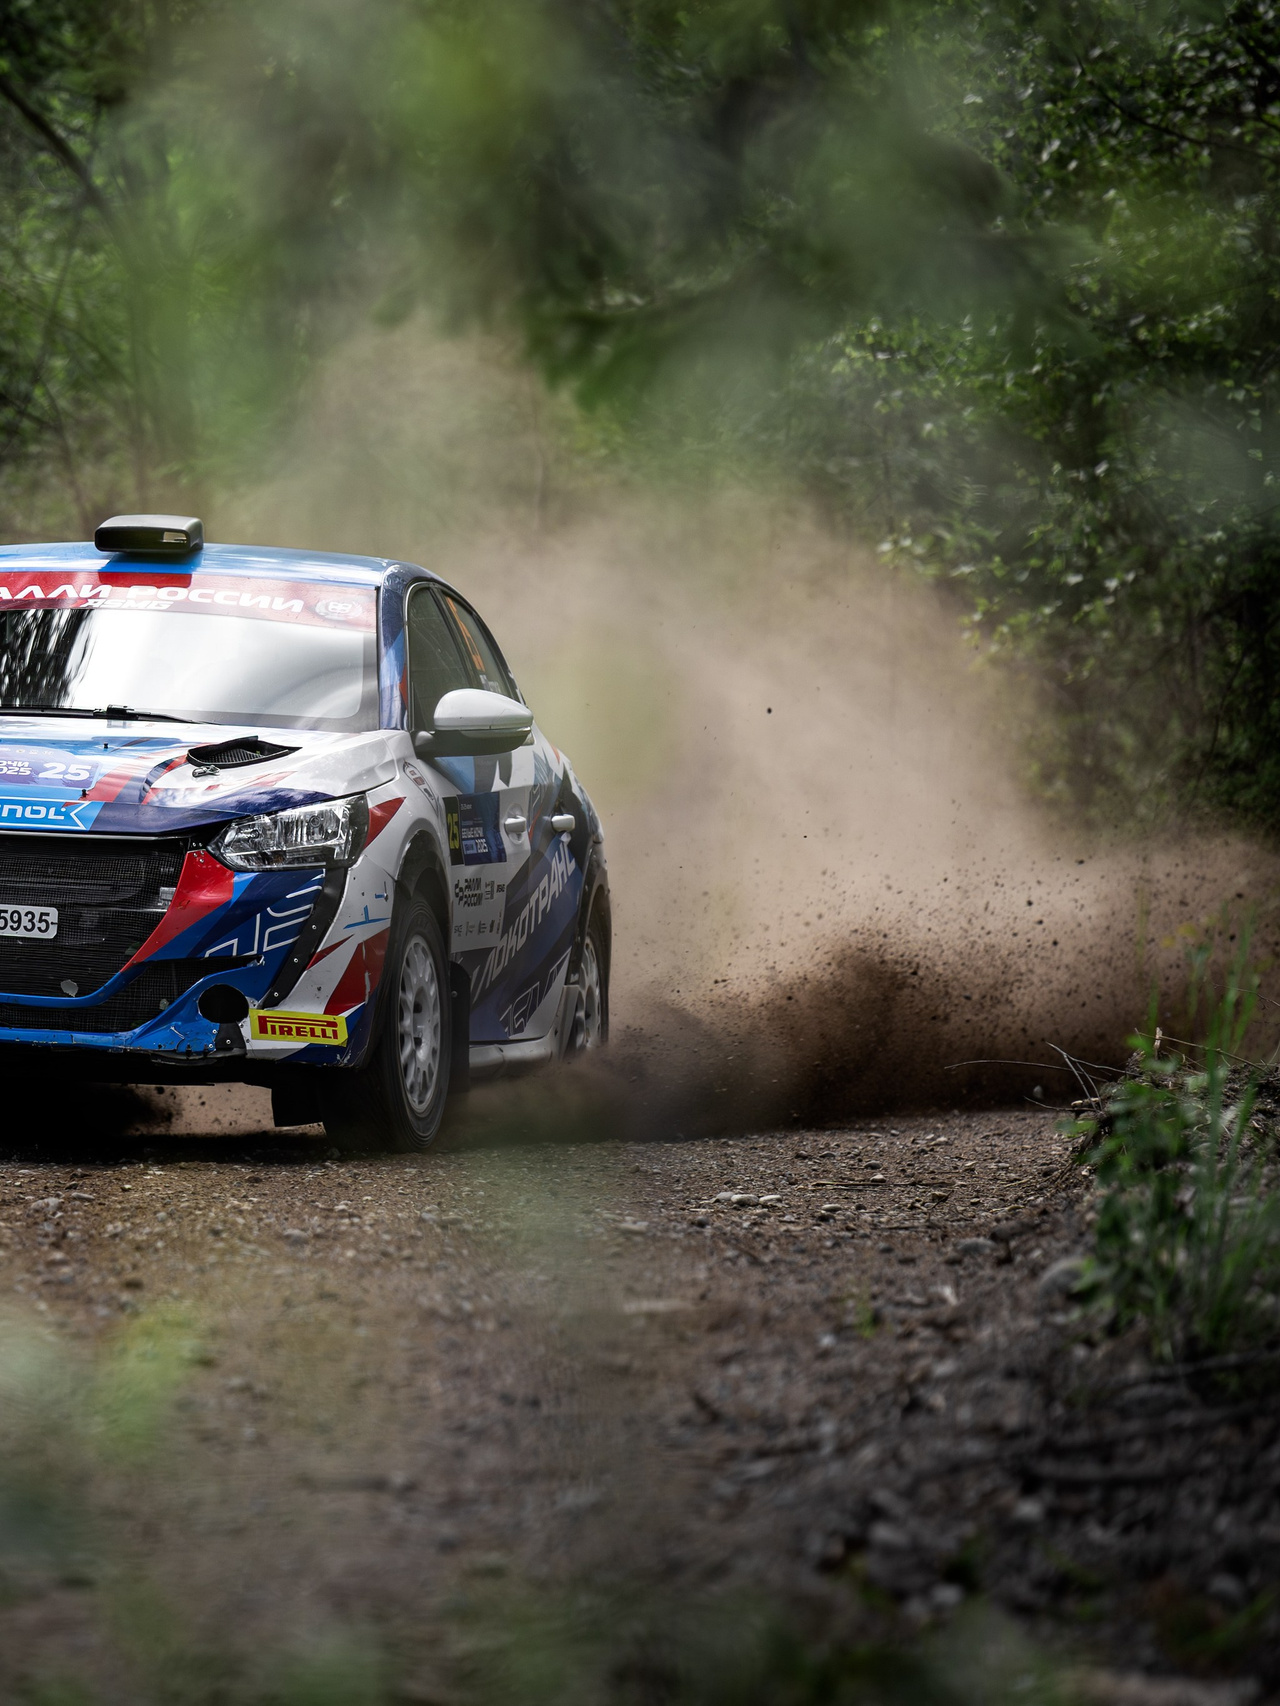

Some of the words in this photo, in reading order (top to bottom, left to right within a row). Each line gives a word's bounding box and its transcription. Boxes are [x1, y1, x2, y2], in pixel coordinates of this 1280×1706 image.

[125, 585, 305, 613] РОССИИ
[38, 762, 92, 781] 25
[447, 813, 460, 849] 25
[257, 1015, 339, 1040] PIRELLI
